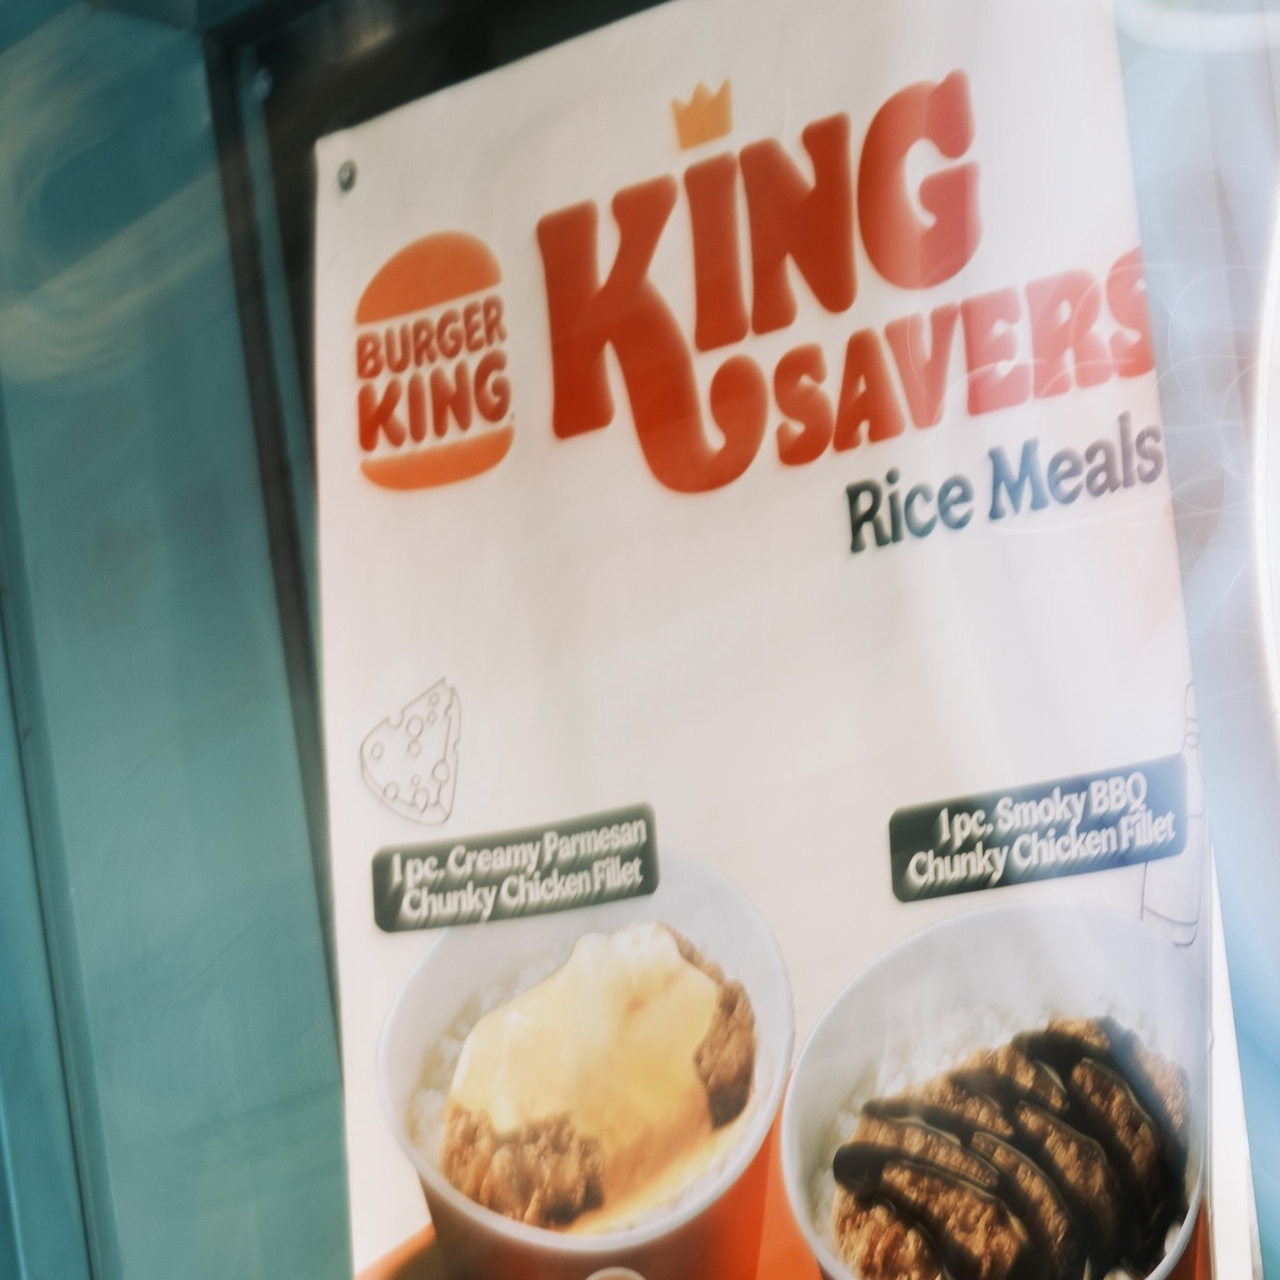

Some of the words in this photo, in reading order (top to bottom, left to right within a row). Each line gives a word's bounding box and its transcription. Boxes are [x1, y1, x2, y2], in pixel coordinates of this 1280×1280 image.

[536, 68, 983, 494] KING
[357, 295, 507, 380] BURGER
[774, 246, 1155, 466] SAVERS
[358, 350, 511, 452] KING
[846, 466, 974, 553] Rice
[988, 410, 1164, 520] Meals
[998, 786, 1087, 830] Smoky
[1090, 771, 1147, 812] BBQ
[401, 881, 497, 921] Chunky
[501, 868, 592, 905] Chicken
[591, 856, 643, 890] Fillet
[448, 840, 540, 875] Creamy
[543, 819, 647, 860] Parmesan
[908, 841, 1009, 884] Chunky
[1012, 822, 1117, 867] Chicken
[1120, 810, 1176, 849] Fillet
